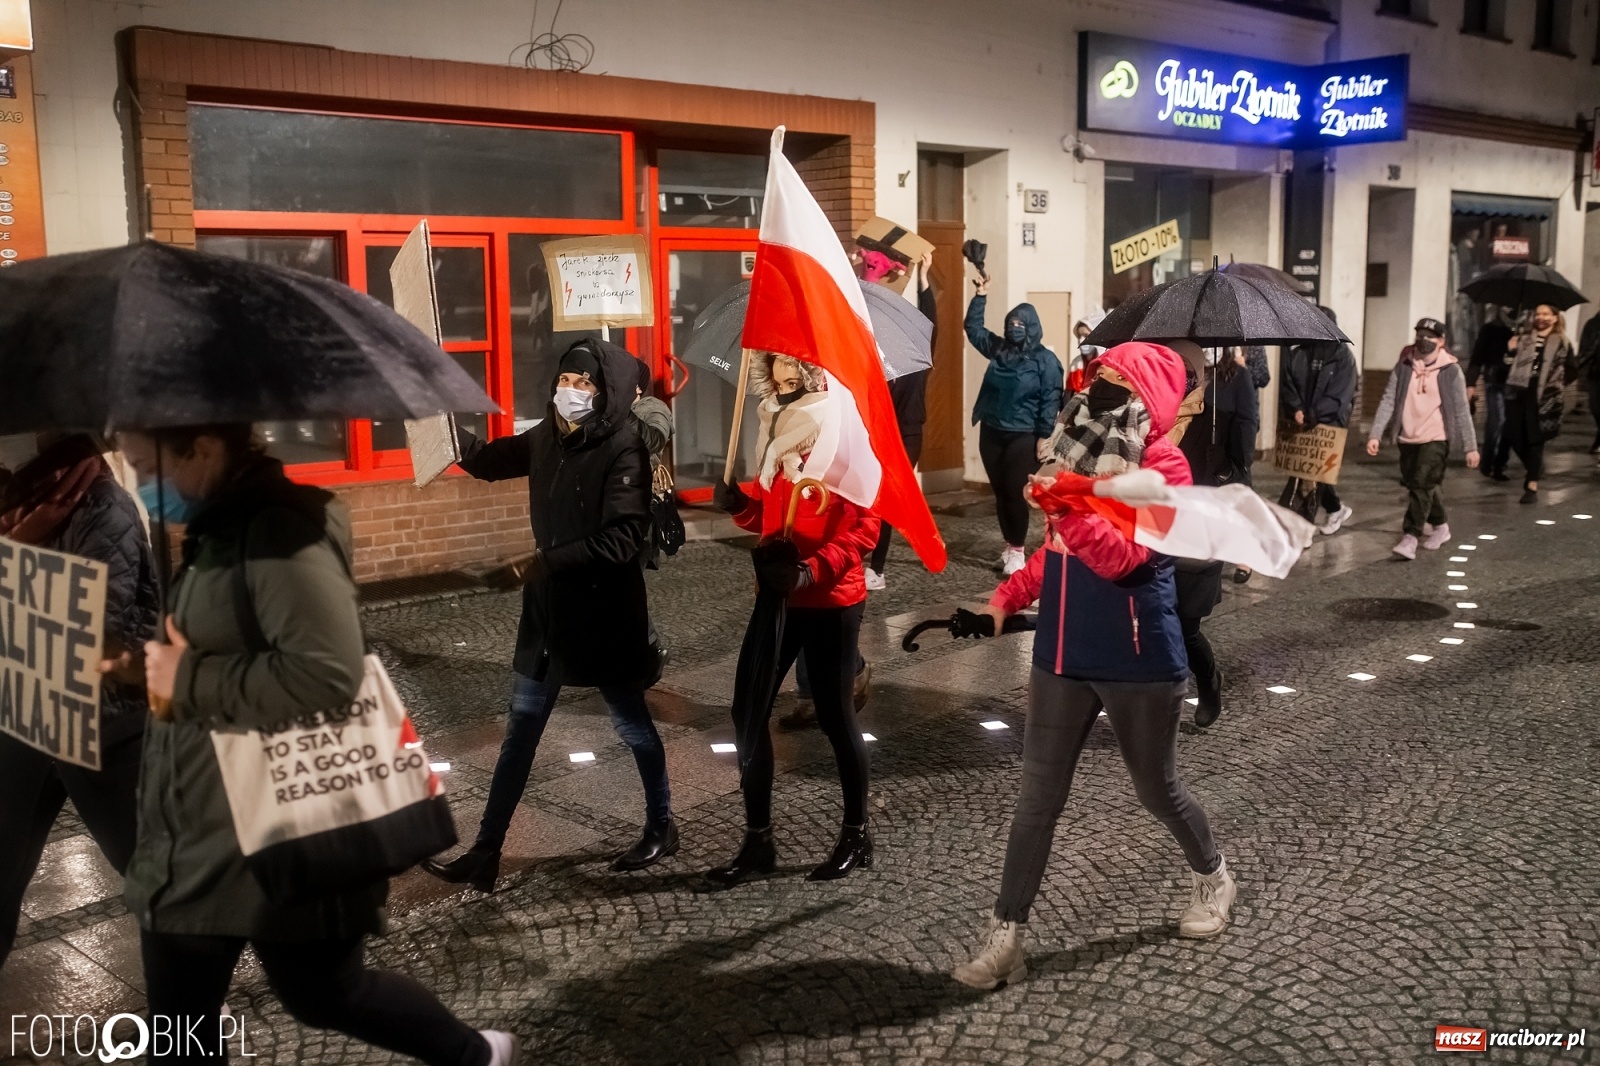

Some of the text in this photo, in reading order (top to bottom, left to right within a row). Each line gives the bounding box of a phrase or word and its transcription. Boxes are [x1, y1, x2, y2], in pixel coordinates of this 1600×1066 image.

[1155, 59, 1232, 121] Jubiler
[1320, 75, 1389, 110] Jubiler
[1031, 193, 1047, 208] 36
[560, 253, 588, 270] Jarek
[1114, 227, 1177, 267] ZŁOTO -10%
[709, 355, 731, 371] SELVE
[264, 728, 344, 762] TO STAY
[271, 744, 377, 785] IS A GOOD
[275, 753, 423, 805] REASON TO GO
